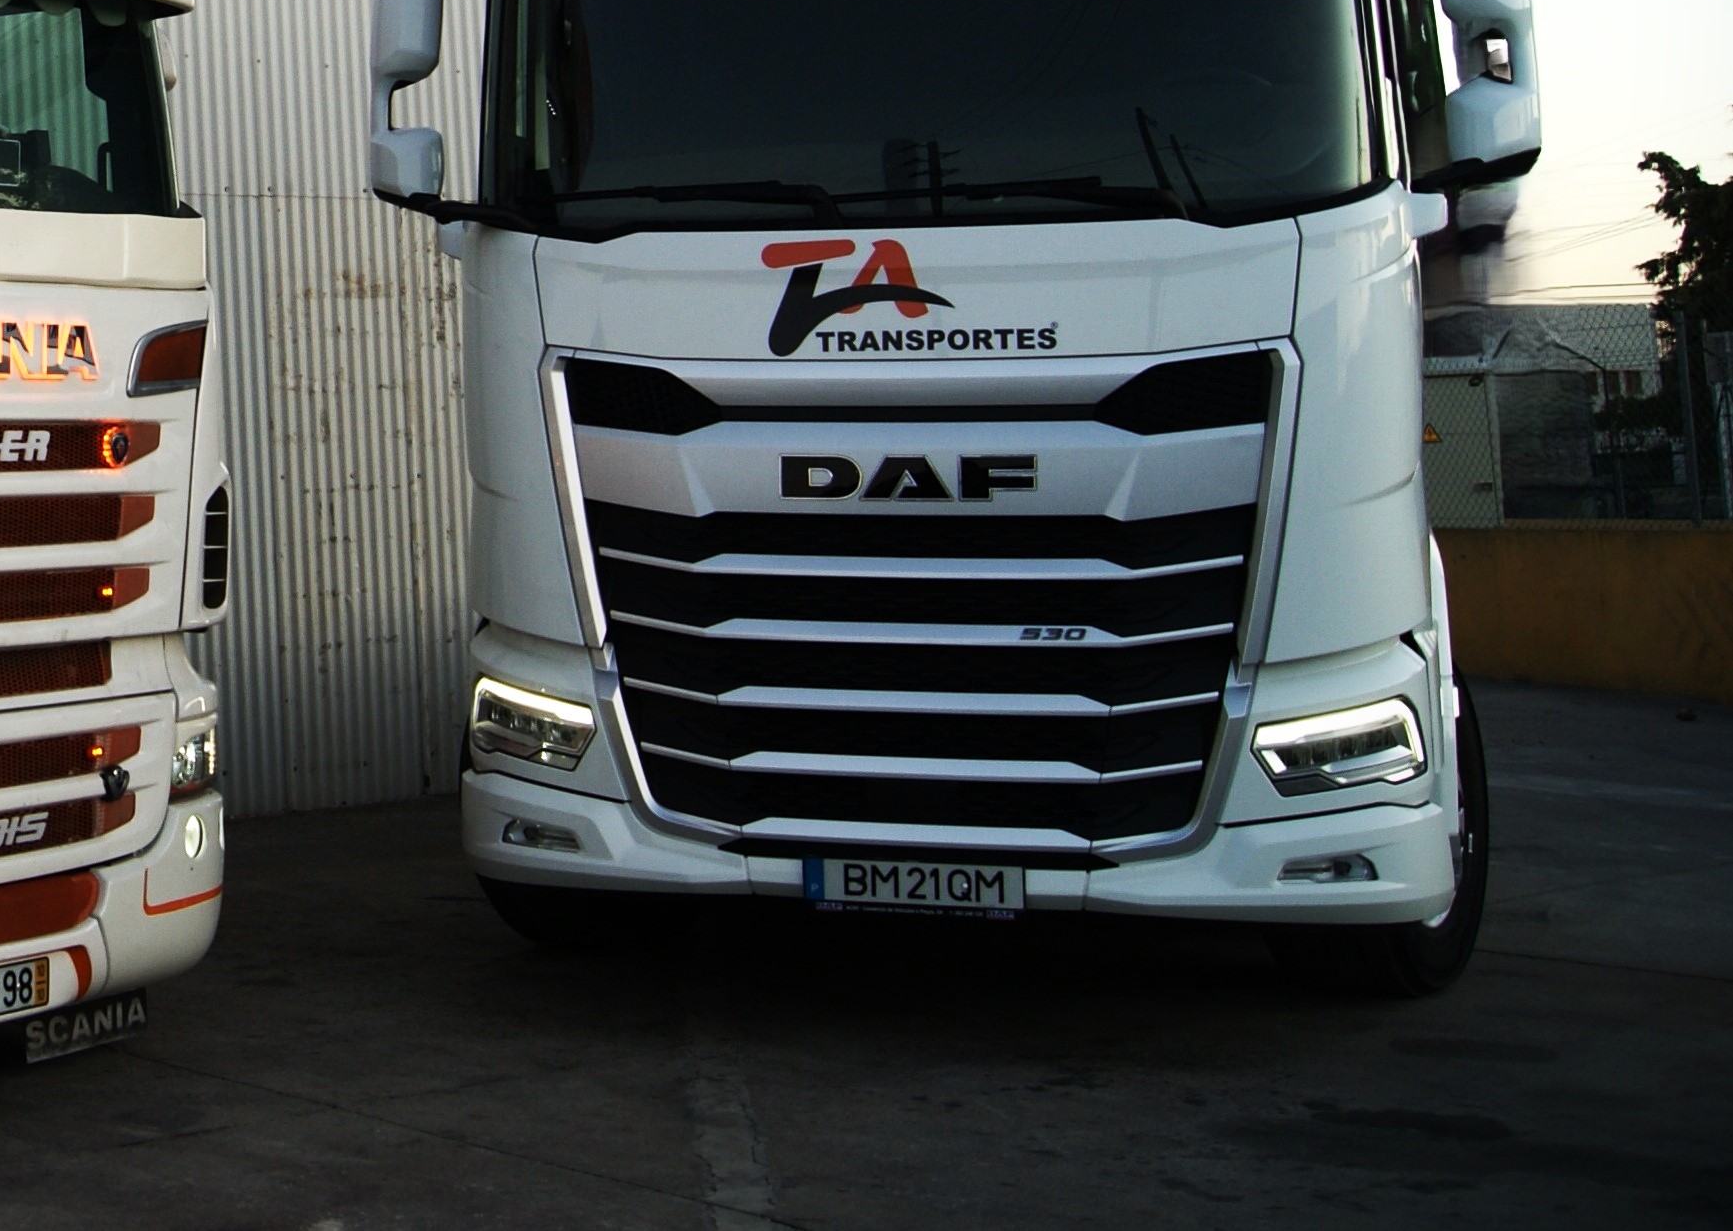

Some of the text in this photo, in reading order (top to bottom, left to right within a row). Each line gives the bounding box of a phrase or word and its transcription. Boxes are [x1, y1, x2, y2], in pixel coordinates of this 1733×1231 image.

[816, 326, 1058, 352] TRANSPORTES
[778, 453, 1039, 503] DAF
[1018, 627, 1087, 641] 530
[25, 995, 147, 1050] SCANIA
